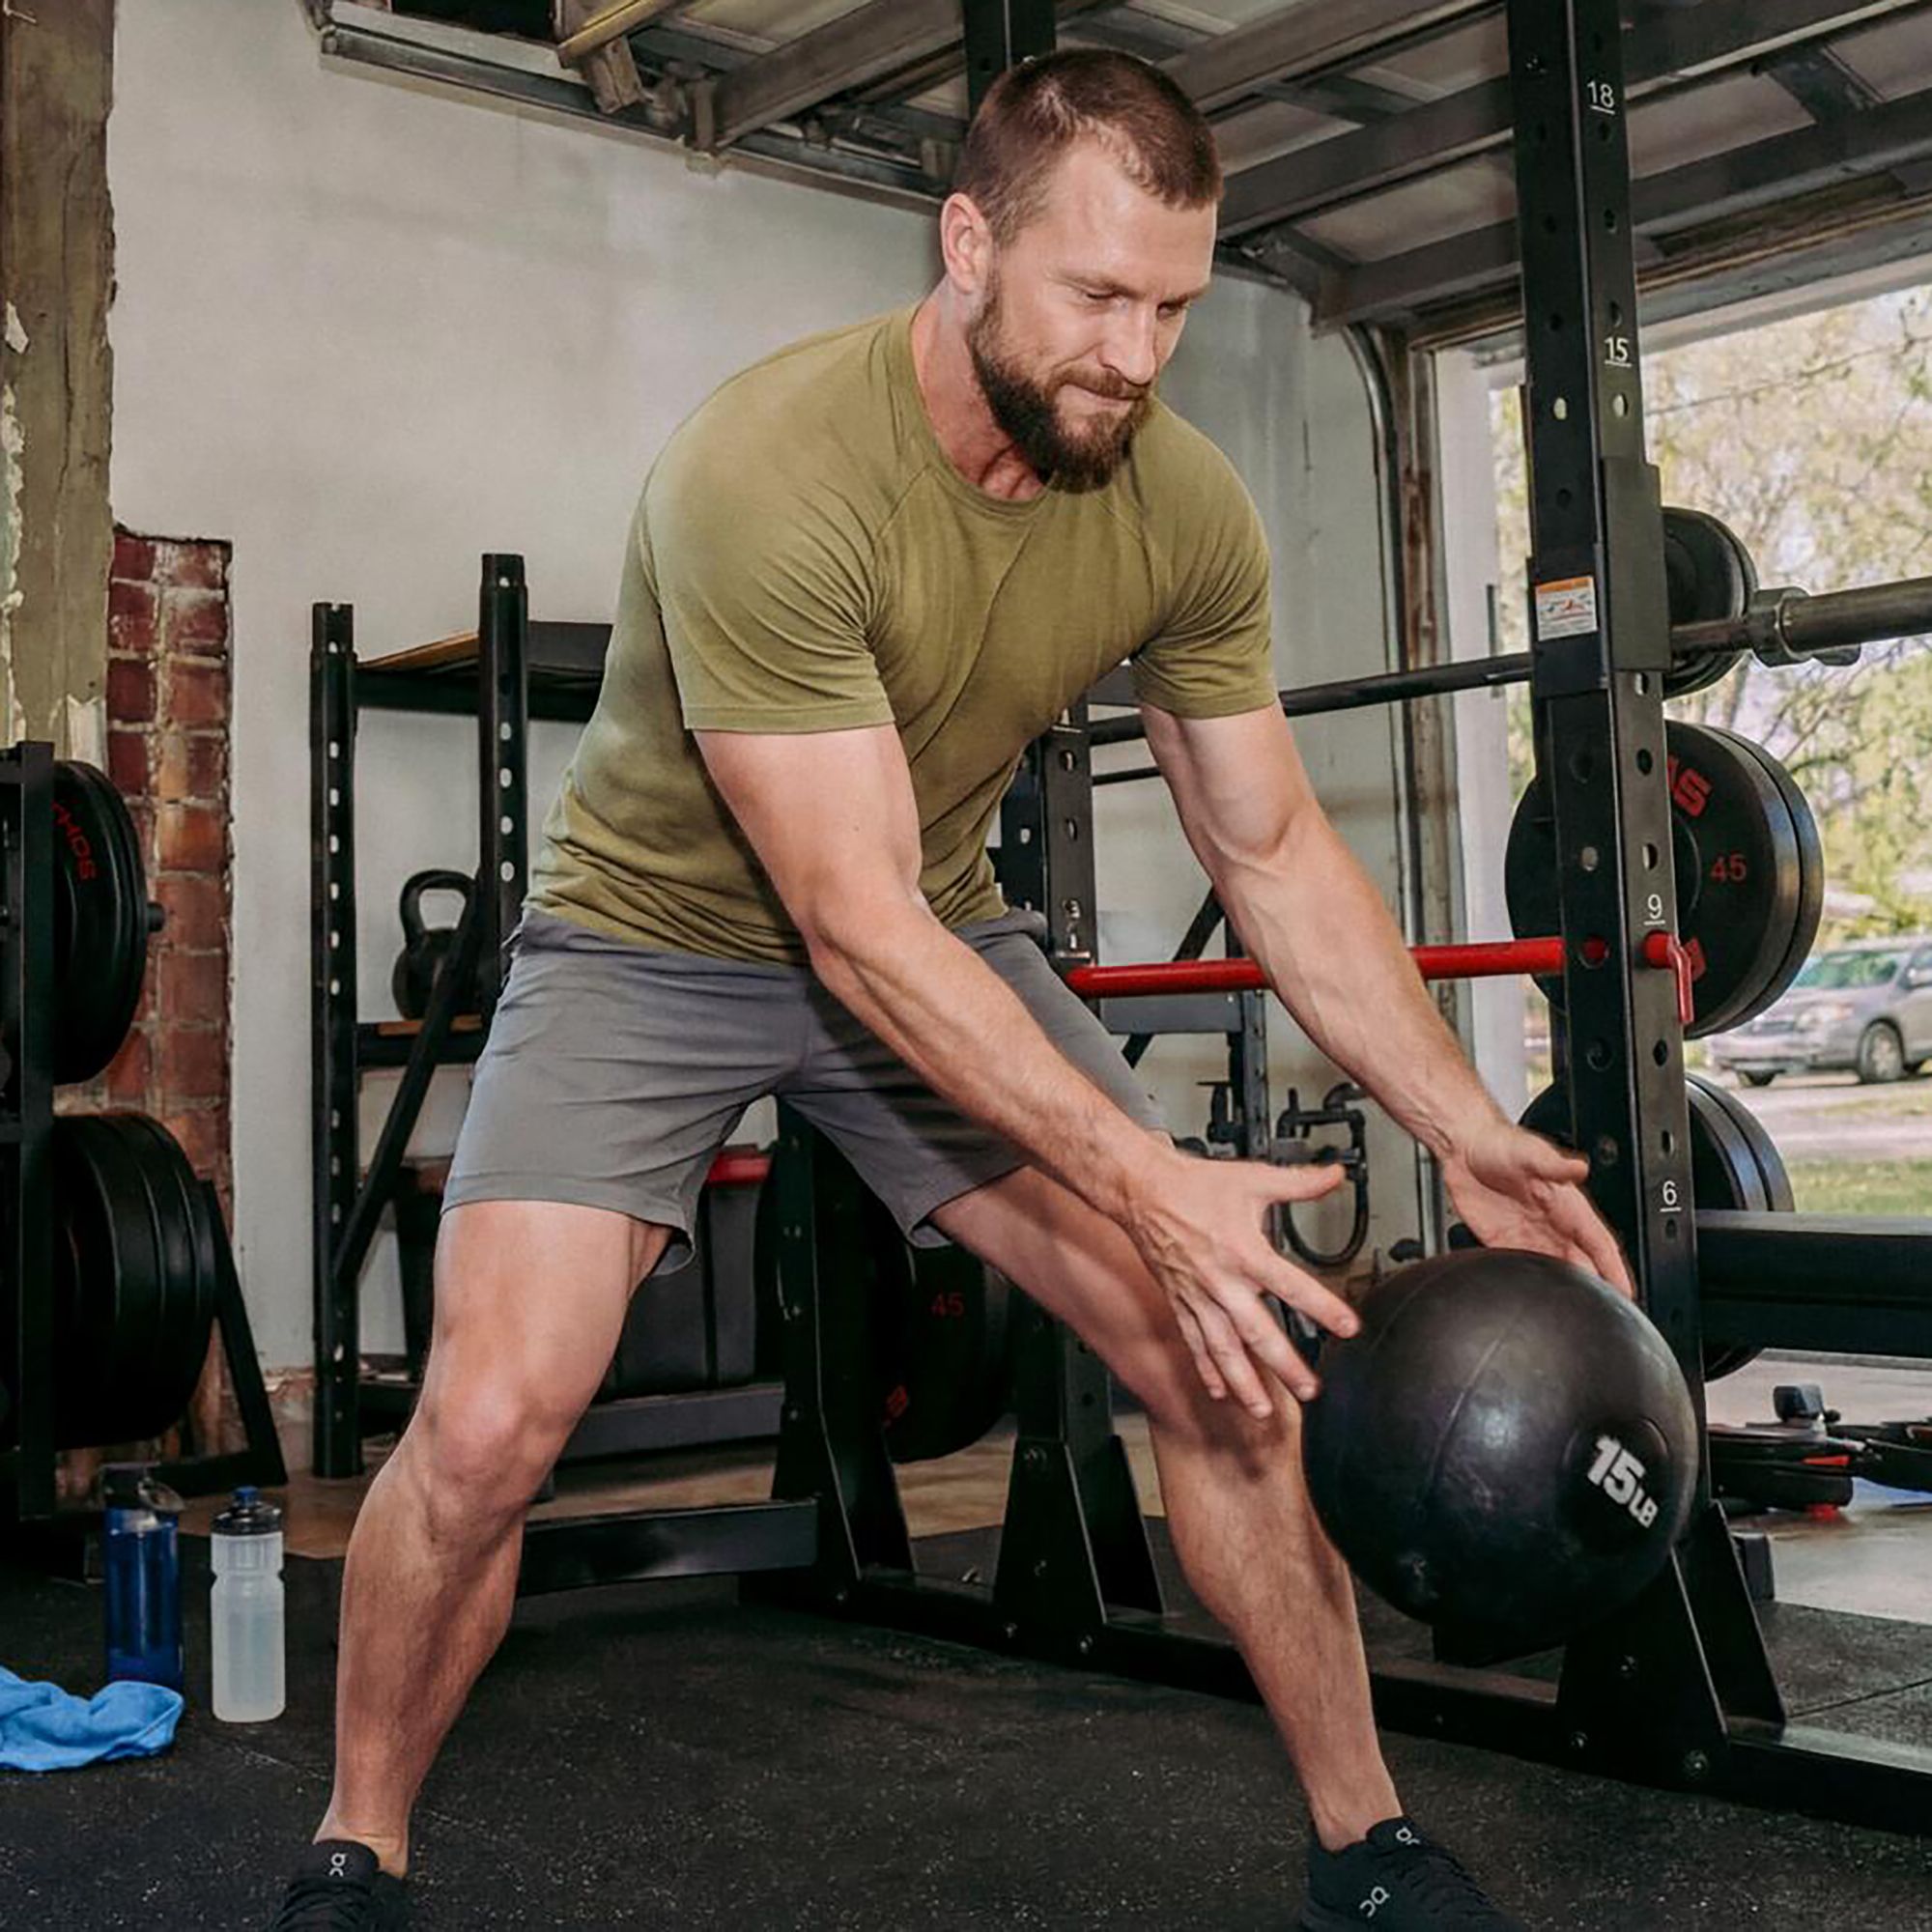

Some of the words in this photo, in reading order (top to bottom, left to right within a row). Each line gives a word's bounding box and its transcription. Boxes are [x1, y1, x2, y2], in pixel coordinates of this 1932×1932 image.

[1587, 80, 1614, 108] 18
[1605, 337, 1629, 362] 15
[1710, 854, 1747, 883] 45
[1648, 895, 1662, 920] 9
[1662, 1180, 1677, 1206] 6
[930, 1292, 964, 1318] 45
